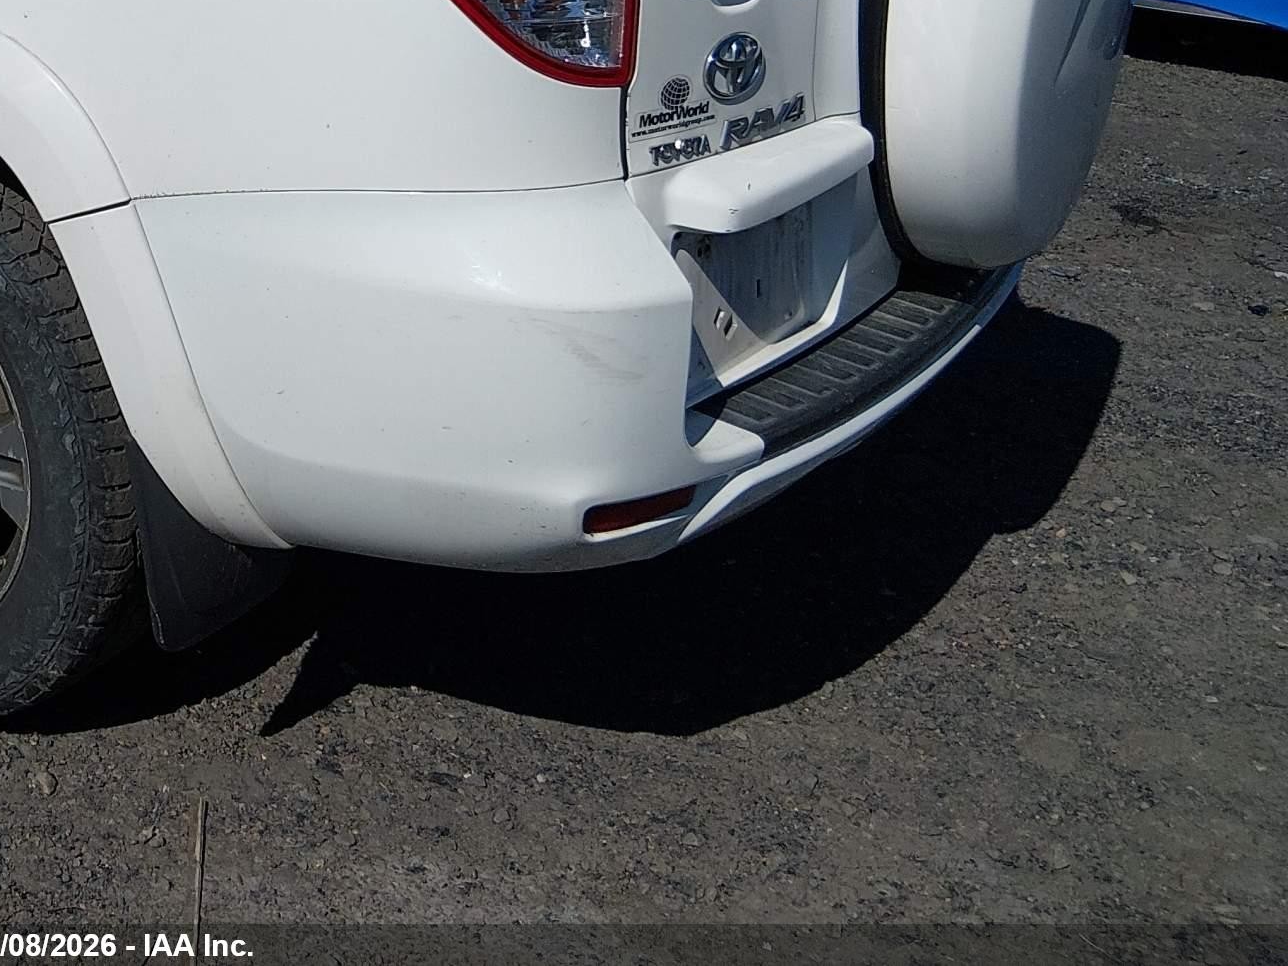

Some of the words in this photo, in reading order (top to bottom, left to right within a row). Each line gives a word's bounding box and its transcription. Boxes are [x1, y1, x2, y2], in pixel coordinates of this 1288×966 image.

[639, 101, 710, 128] MotorWorld
[720, 92, 805, 151] RAV4
[649, 134, 711, 166] TOYOTA
